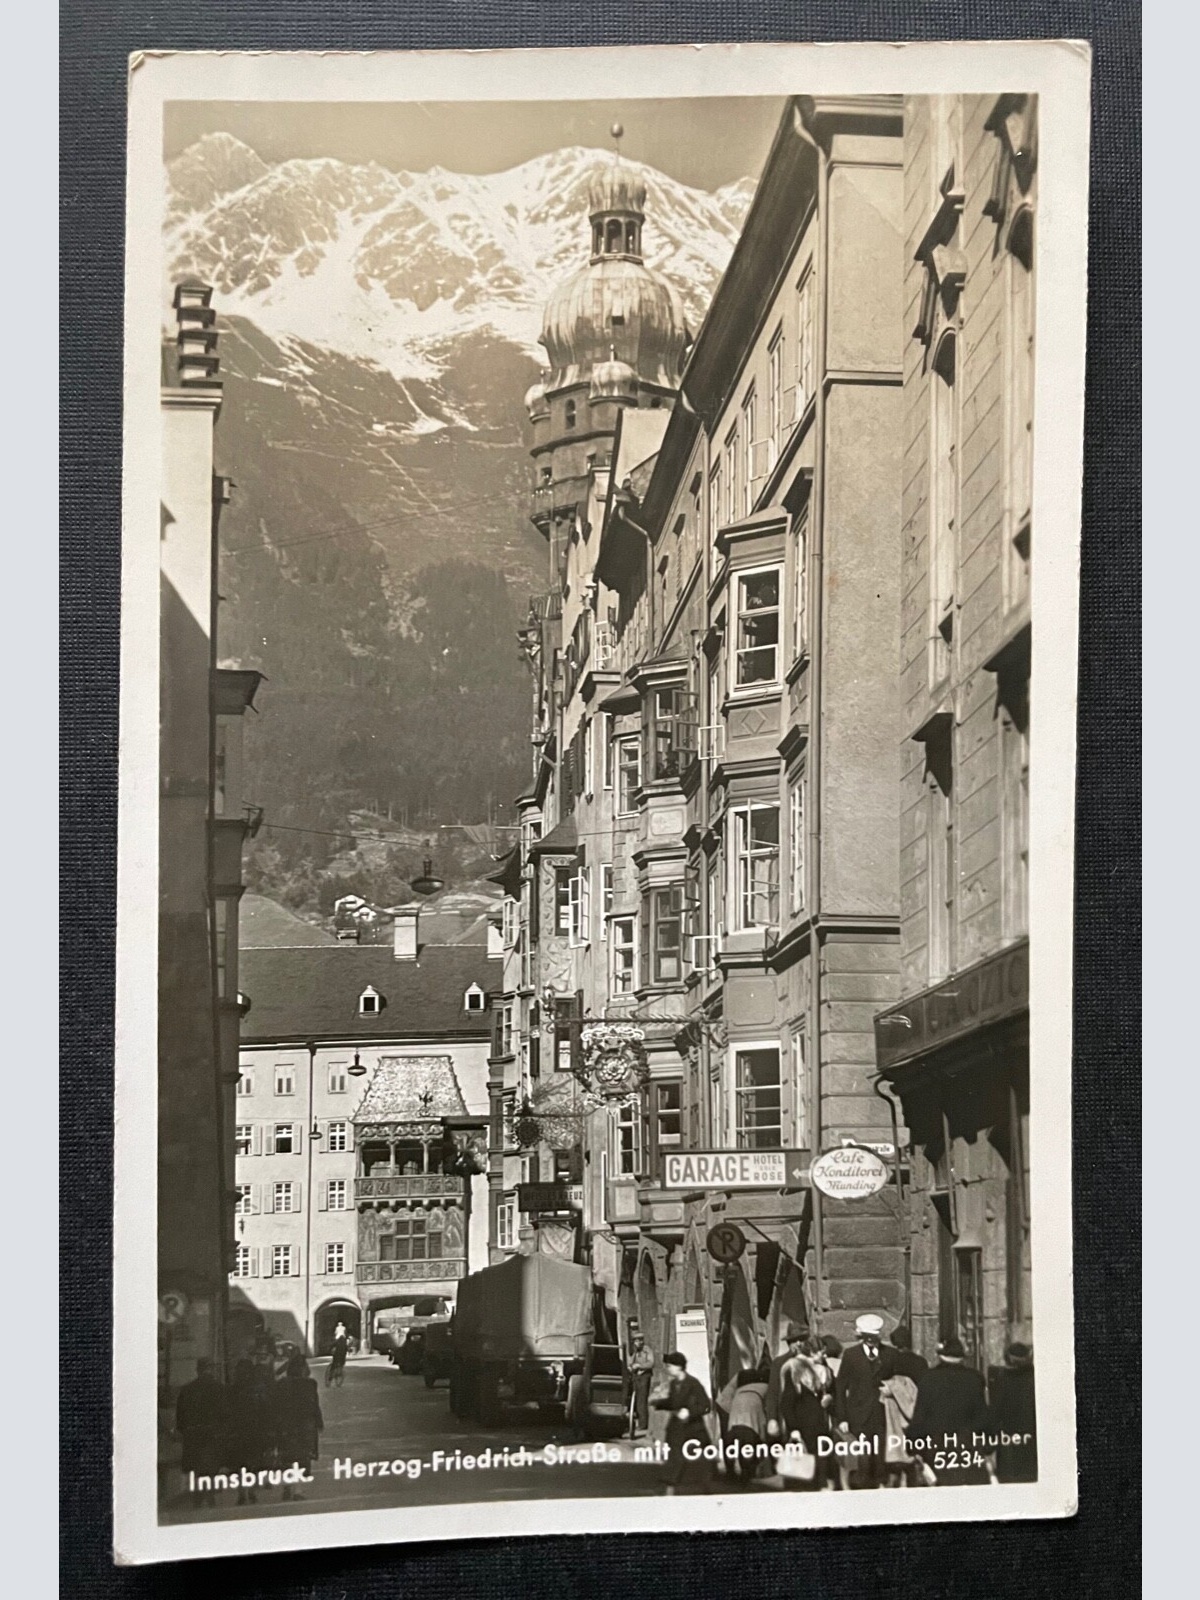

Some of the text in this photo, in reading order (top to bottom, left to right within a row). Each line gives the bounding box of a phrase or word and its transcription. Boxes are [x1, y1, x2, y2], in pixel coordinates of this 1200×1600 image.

[753, 1155, 783, 1165] HOTEL
[668, 1156, 750, 1183] GARAGE
[815, 1165, 884, 1178] Konditorei
[753, 1171, 783, 1181] ROSE
